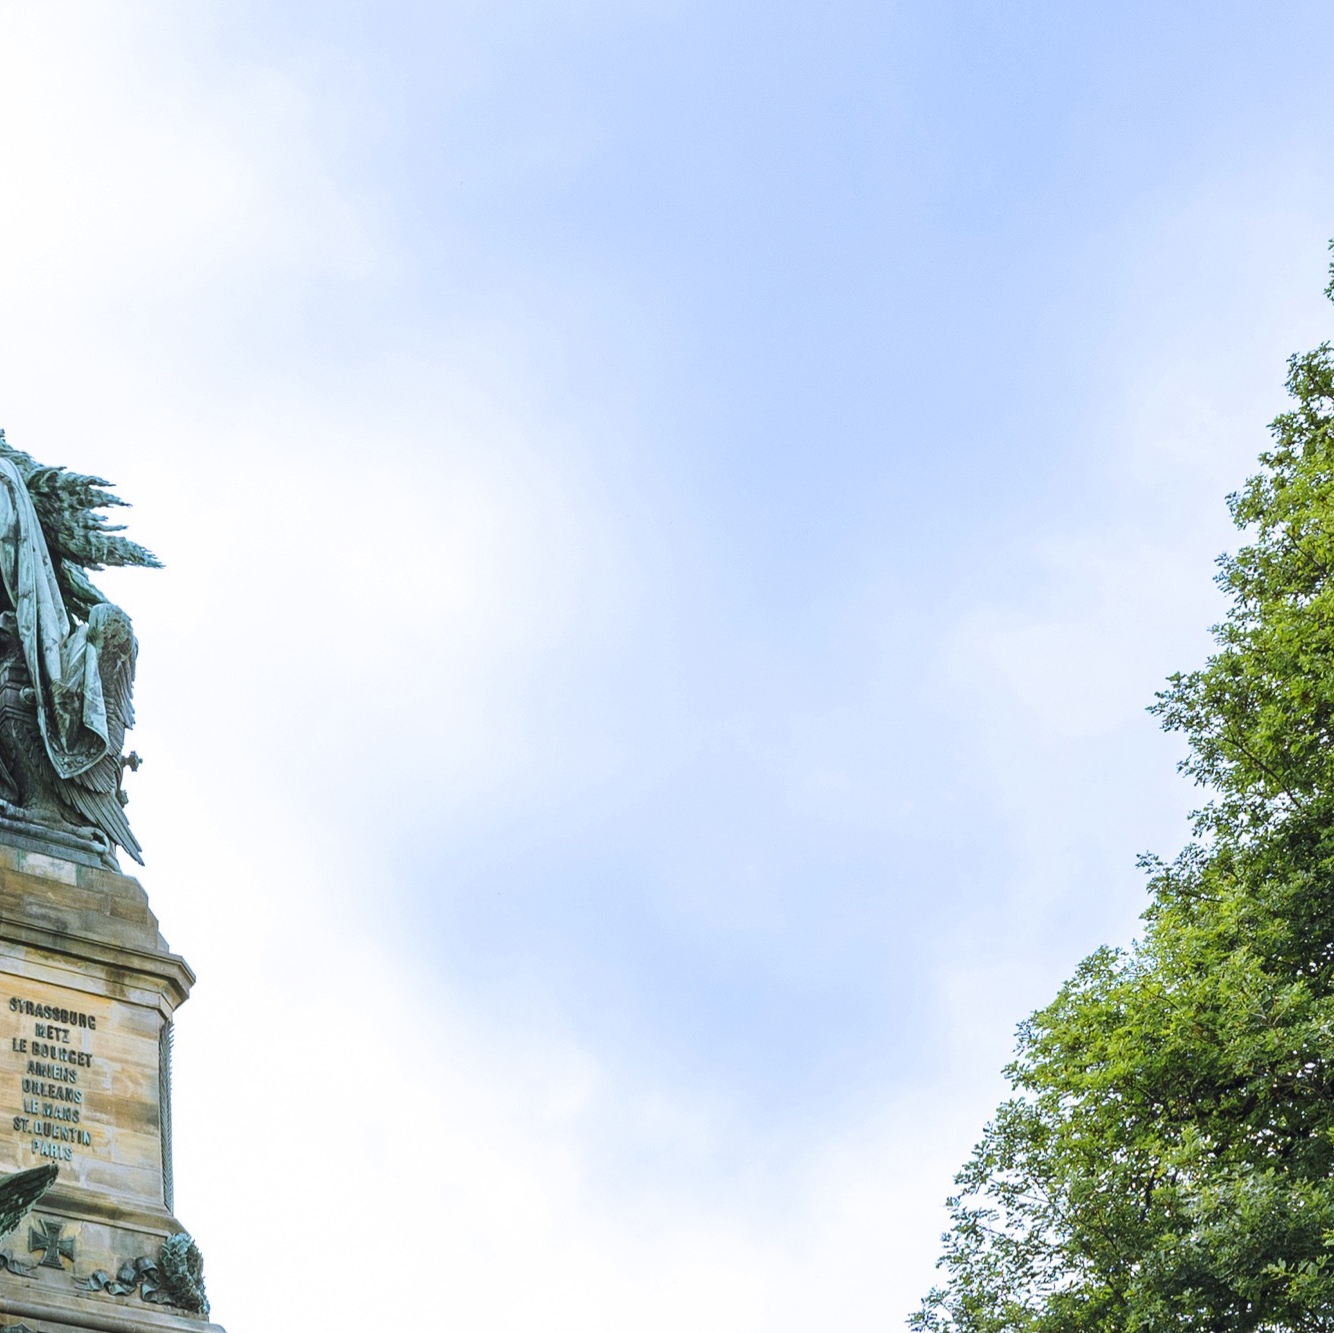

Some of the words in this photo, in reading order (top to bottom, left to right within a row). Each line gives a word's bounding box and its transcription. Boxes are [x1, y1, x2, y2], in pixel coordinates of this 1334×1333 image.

[9, 997, 96, 1030] STRASSBURG
[35, 1022, 70, 1043] METZ
[12, 1037, 27, 1053] LE
[31, 1041, 92, 1068] BOURGET
[26, 1060, 77, 1084] AMIENS
[22, 1078, 82, 1104] ORLEANS
[24, 1098, 38, 1115] LE
[42, 1102, 80, 1123] MANS
[13, 1116, 32, 1134] ST.
[34, 1120, 91, 1147] QUENTIN
[31, 1138, 73, 1161] PARIS
